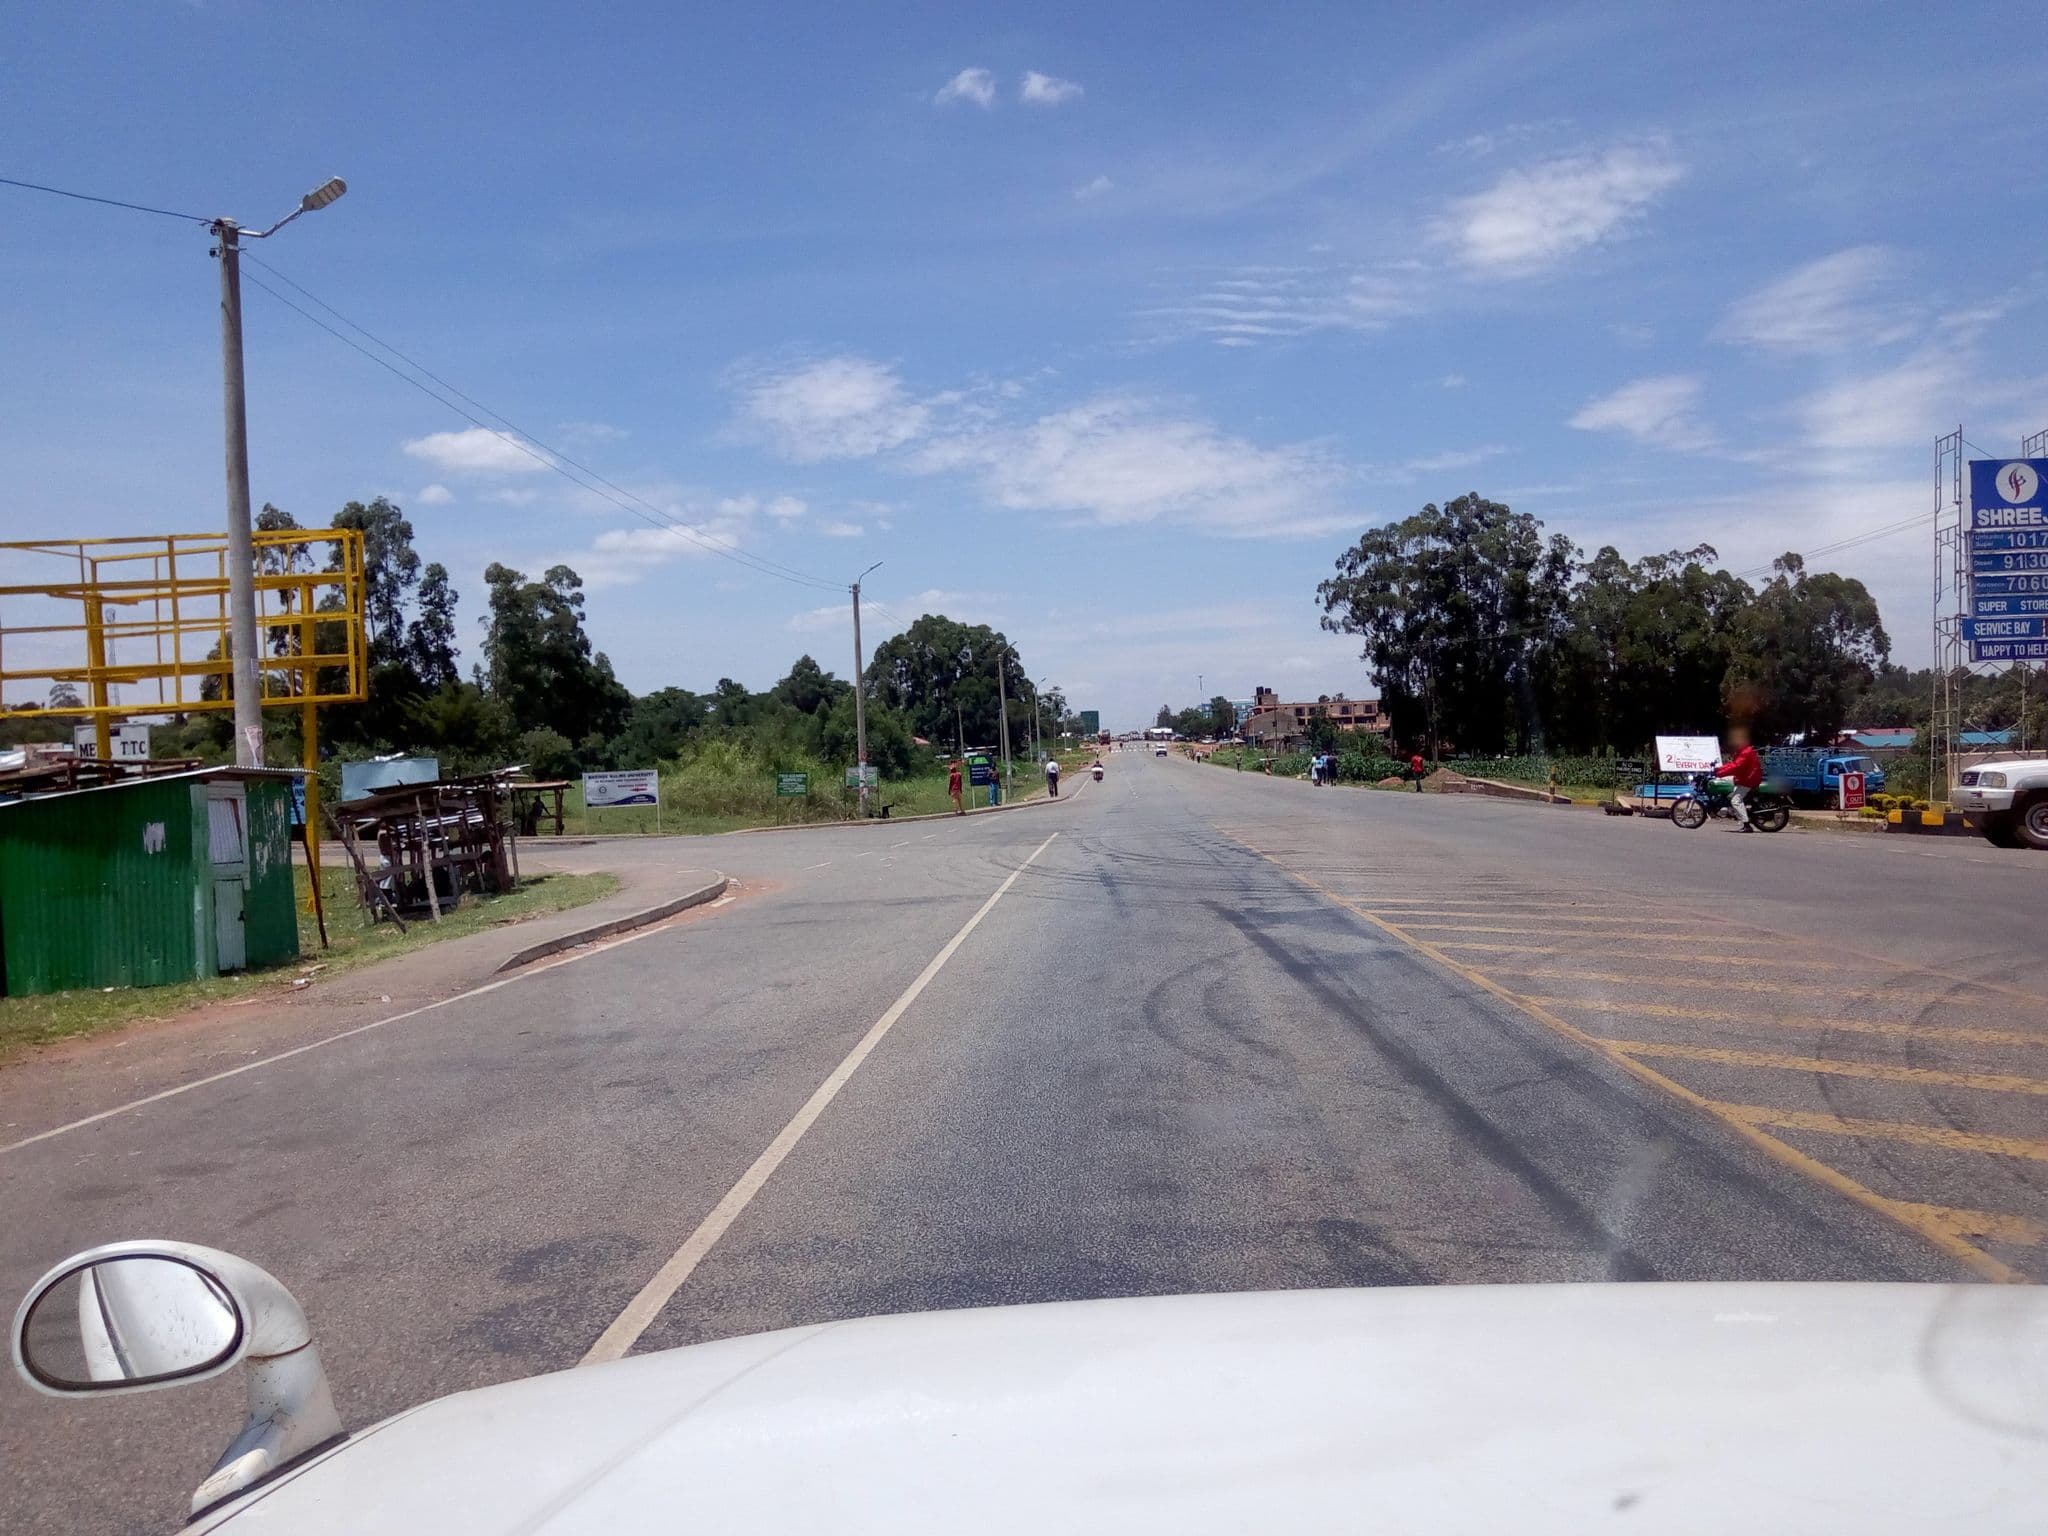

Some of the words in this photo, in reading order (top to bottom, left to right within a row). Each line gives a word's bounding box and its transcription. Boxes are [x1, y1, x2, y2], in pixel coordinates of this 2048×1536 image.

[1978, 601, 2008, 612] SUPER
[1974, 622, 2012, 636] SERVICE
[2014, 621, 2031, 634] BAY
[1981, 645, 2011, 657] HAPPY
[2013, 644, 2026, 656] TO
[79, 742, 97, 757] ME
[1675, 761, 1697, 769] EVERY
